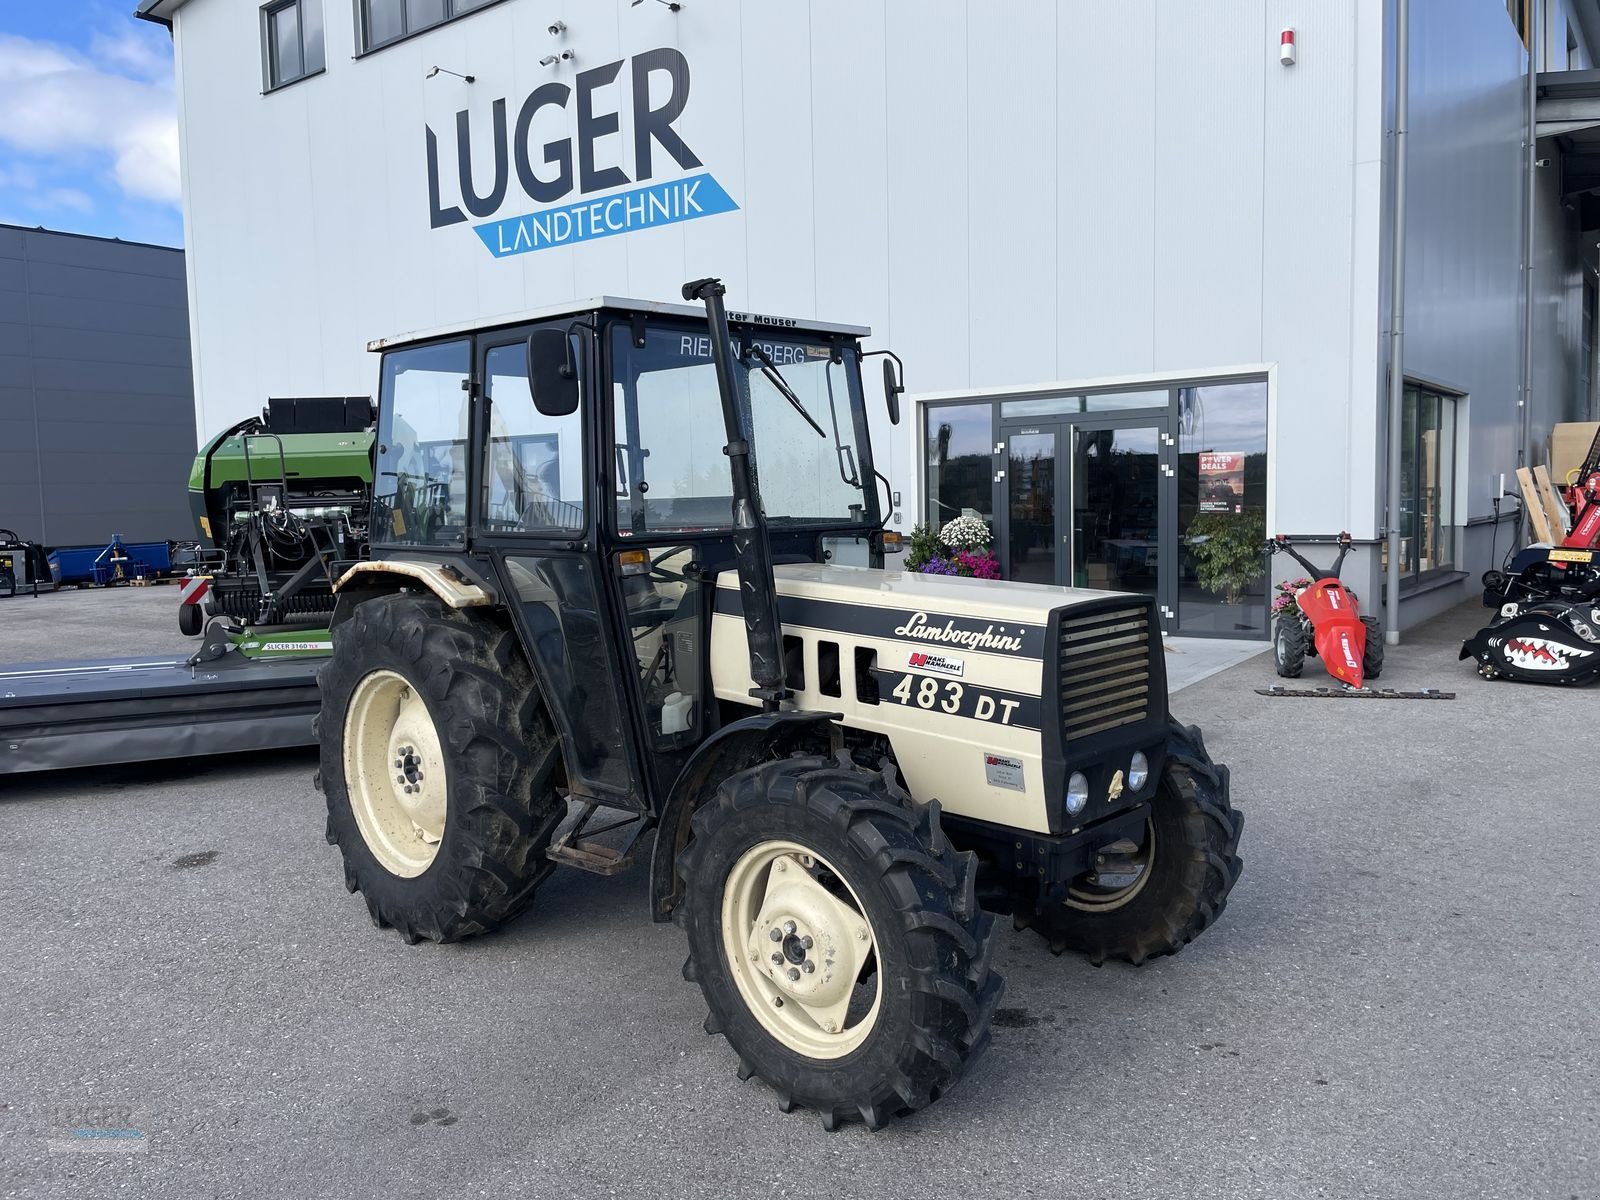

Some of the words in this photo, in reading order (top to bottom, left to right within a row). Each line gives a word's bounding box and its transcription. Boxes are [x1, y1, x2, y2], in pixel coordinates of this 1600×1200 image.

[425, 47, 704, 229] LUGER
[498, 181, 704, 254] LANDTECHNIK
[754, 315, 797, 327] Mauser
[680, 335, 805, 364] RIENBERG
[894, 612, 1026, 651] Lamborghini
[892, 674, 964, 714] 483
[974, 695, 1020, 725] DT
